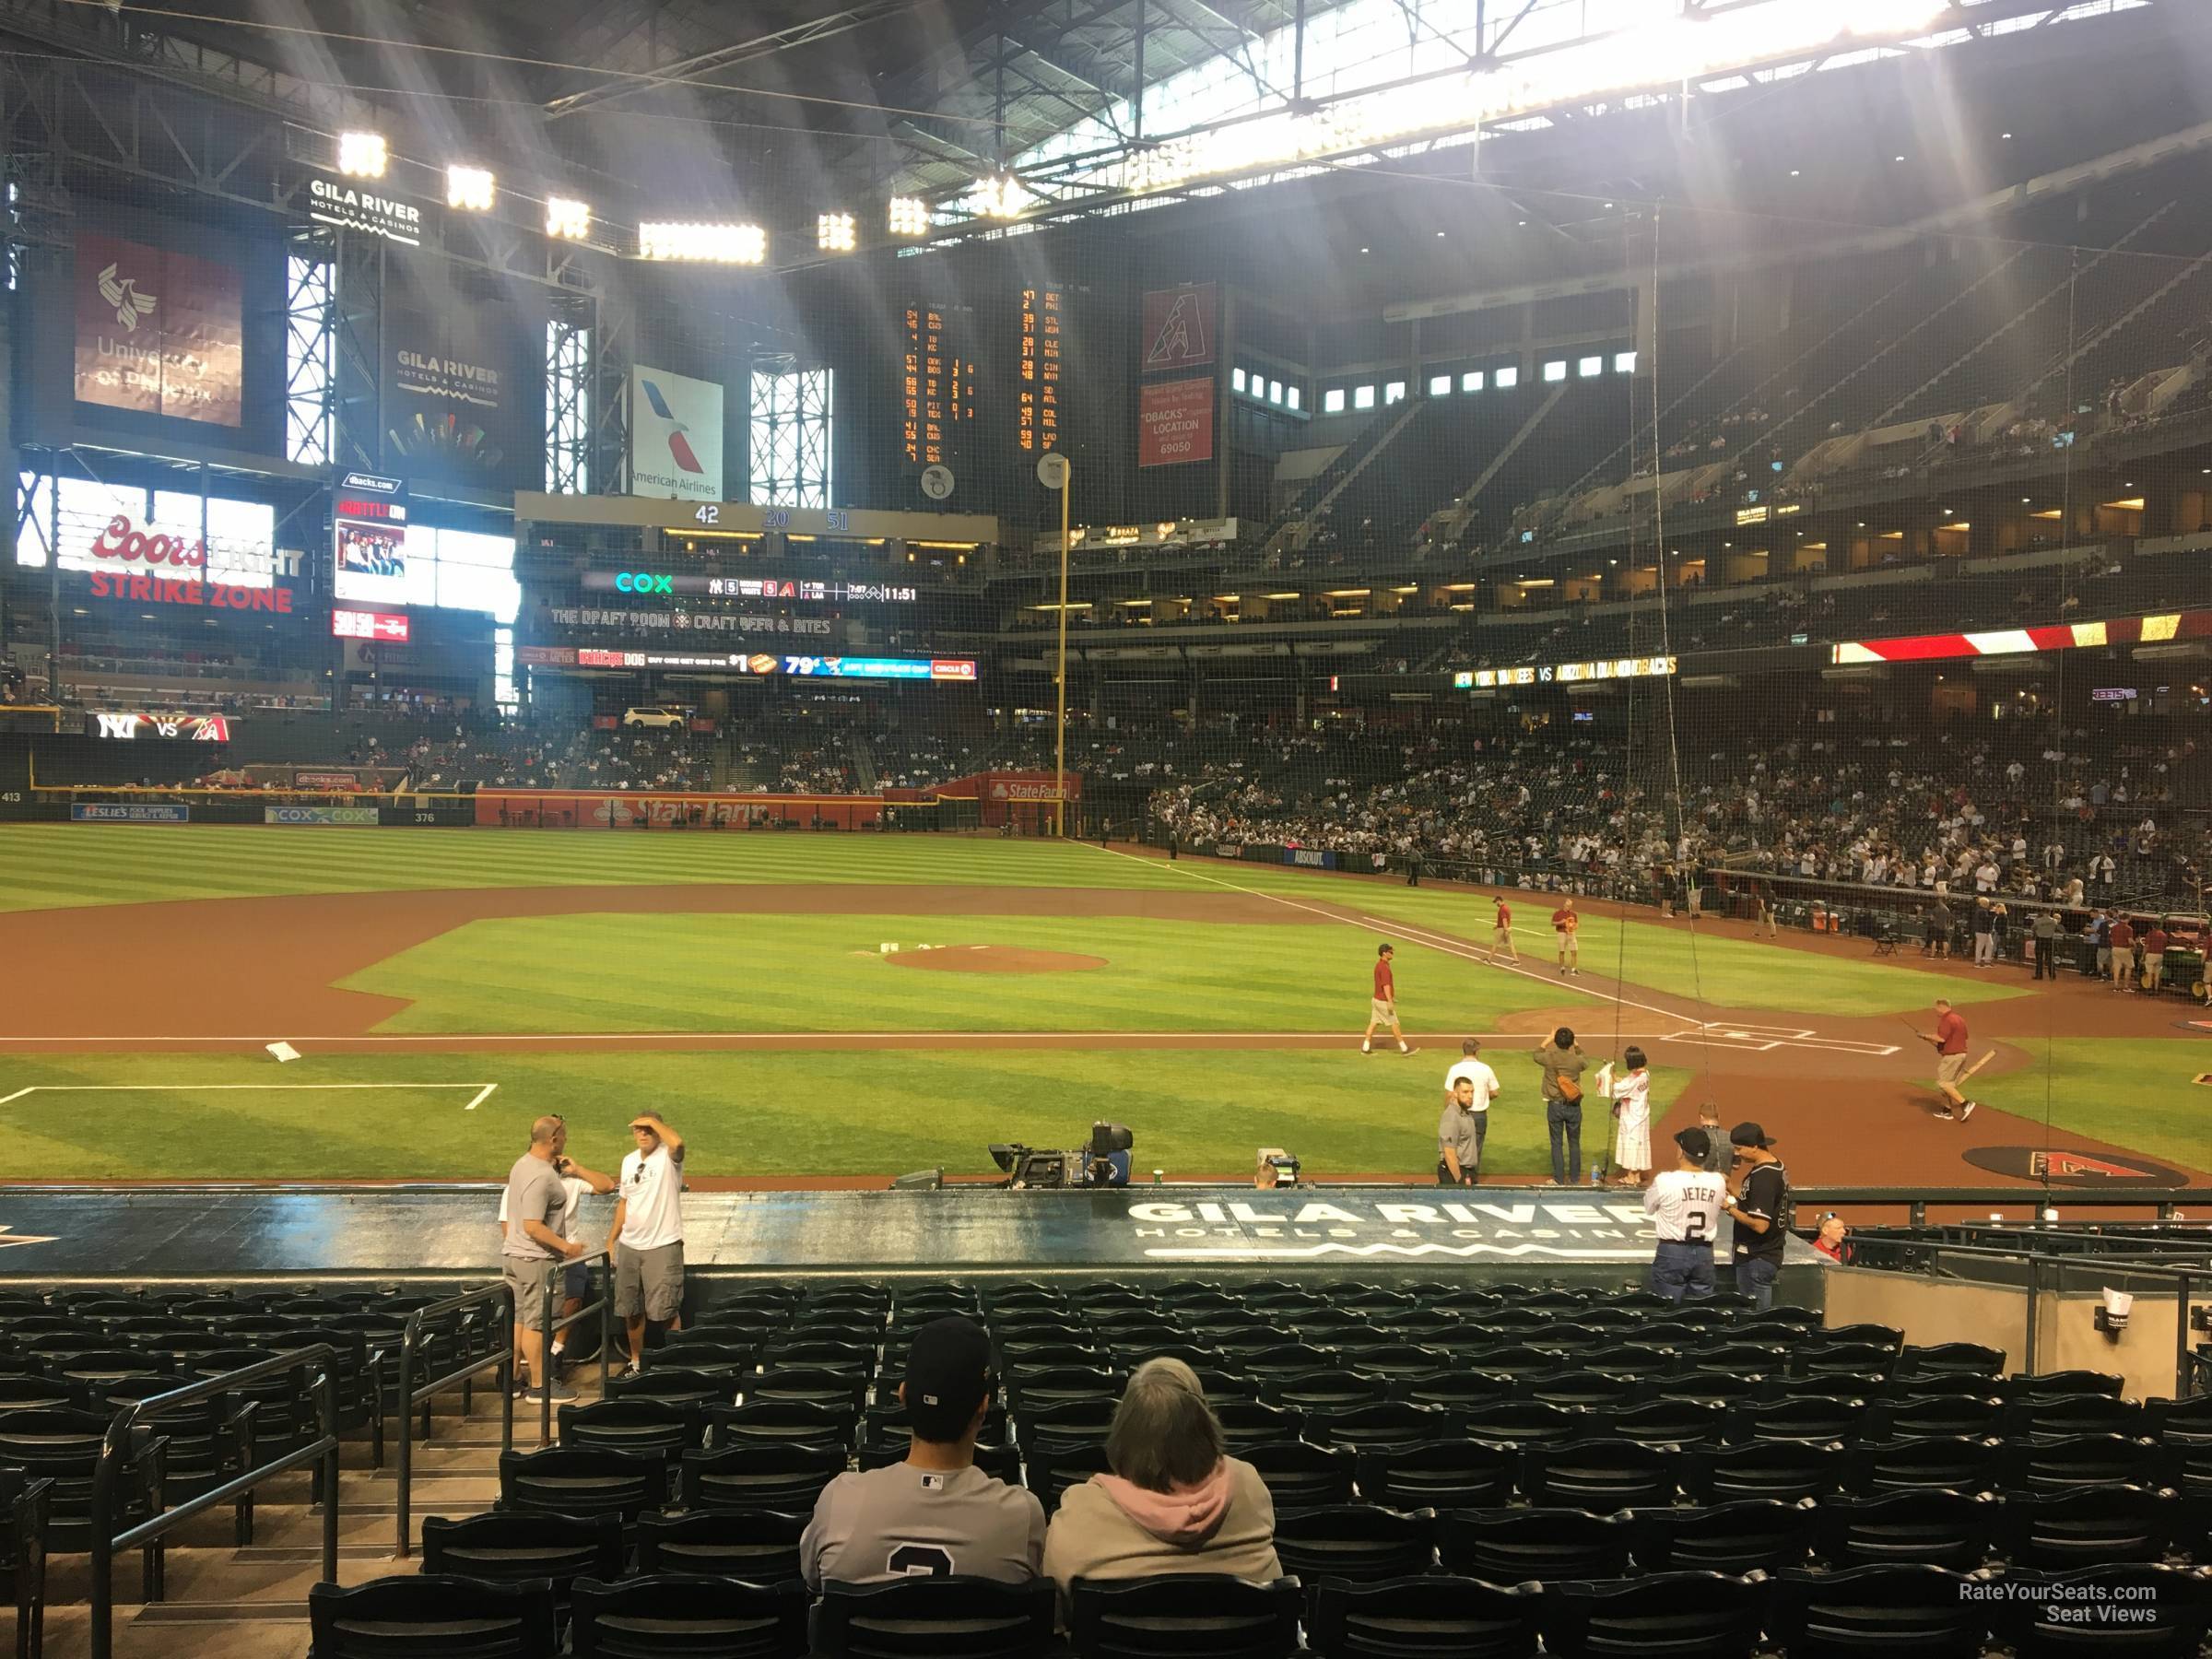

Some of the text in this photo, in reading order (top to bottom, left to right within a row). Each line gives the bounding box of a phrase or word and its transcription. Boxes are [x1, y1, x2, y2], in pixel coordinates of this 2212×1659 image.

[311, 180, 419, 223] GILA RIVER
[311, 199, 355, 217] HOTELS
[372, 217, 419, 234] CASINOS
[1023, 290, 1034, 300] 47
[1023, 300, 1029, 309] 2
[1023, 313, 1034, 323] 39
[1023, 324, 1033, 332] 31
[1022, 337, 1033, 347] 28
[1022, 347, 1033, 356] 31
[397, 350, 498, 384] GILA RIVER
[1022, 360, 1033, 370] 28
[1022, 371, 1033, 380] 48
[397, 370, 437, 382] HOTELS
[454, 381, 498, 395] CASINOS
[953, 381, 958, 389] 2
[953, 390, 958, 398] 3
[1043, 385, 1053, 394] SD
[1021, 393, 1056, 404] 64 ATL
[1021, 407, 1056, 418] 49 COL
[1021, 417, 1056, 427] 57 MIL
[1153, 419, 1199, 435] LOCATION
[1020, 441, 1031, 449] 40
[1161, 441, 1191, 454] 69050
[349, 476, 393, 489] dbacks.com
[678, 477, 716, 496] Airlines
[695, 505, 719, 524] 42
[764, 508, 790, 528] 20
[826, 512, 849, 531] 51
[90, 514, 305, 577] Coors LIGHT
[616, 572, 673, 594] COX
[728, 582, 735, 593] 5
[766, 583, 773, 594] 5
[90, 571, 293, 613] STRIKE ZONE
[850, 585, 866, 594] 7:07
[885, 587, 915, 601] 11:51
[551, 609, 579, 625] THE
[582, 610, 627, 626] DRAFT
[630, 613, 670, 628] ROOM
[694, 616, 736, 630] CRAFT
[778, 619, 789, 632] &
[794, 618, 830, 634] BITES
[624, 653, 644, 665] DOG
[729, 654, 747, 672] $1
[1454, 657, 1677, 688] NEW YORK YANKEES VS ARIZONA DIAMONDBACKS
[157, 723, 177, 736] VS
[299, 775, 353, 785] dbacks.com
[2, 793, 21, 802] 413
[85, 806, 127, 818] LESLIE'S
[278, 809, 312, 820] COX
[332, 810, 365, 821] COX
[637, 799, 701, 823] Stat
[415, 813, 434, 822] 376
[1681, 1186, 1716, 1203] JETER
[1128, 1203, 1656, 1224] GILA RIVER
[1685, 1211, 1706, 1241] 2
[1136, 1228, 1657, 1239] HOTELS & CASINO
